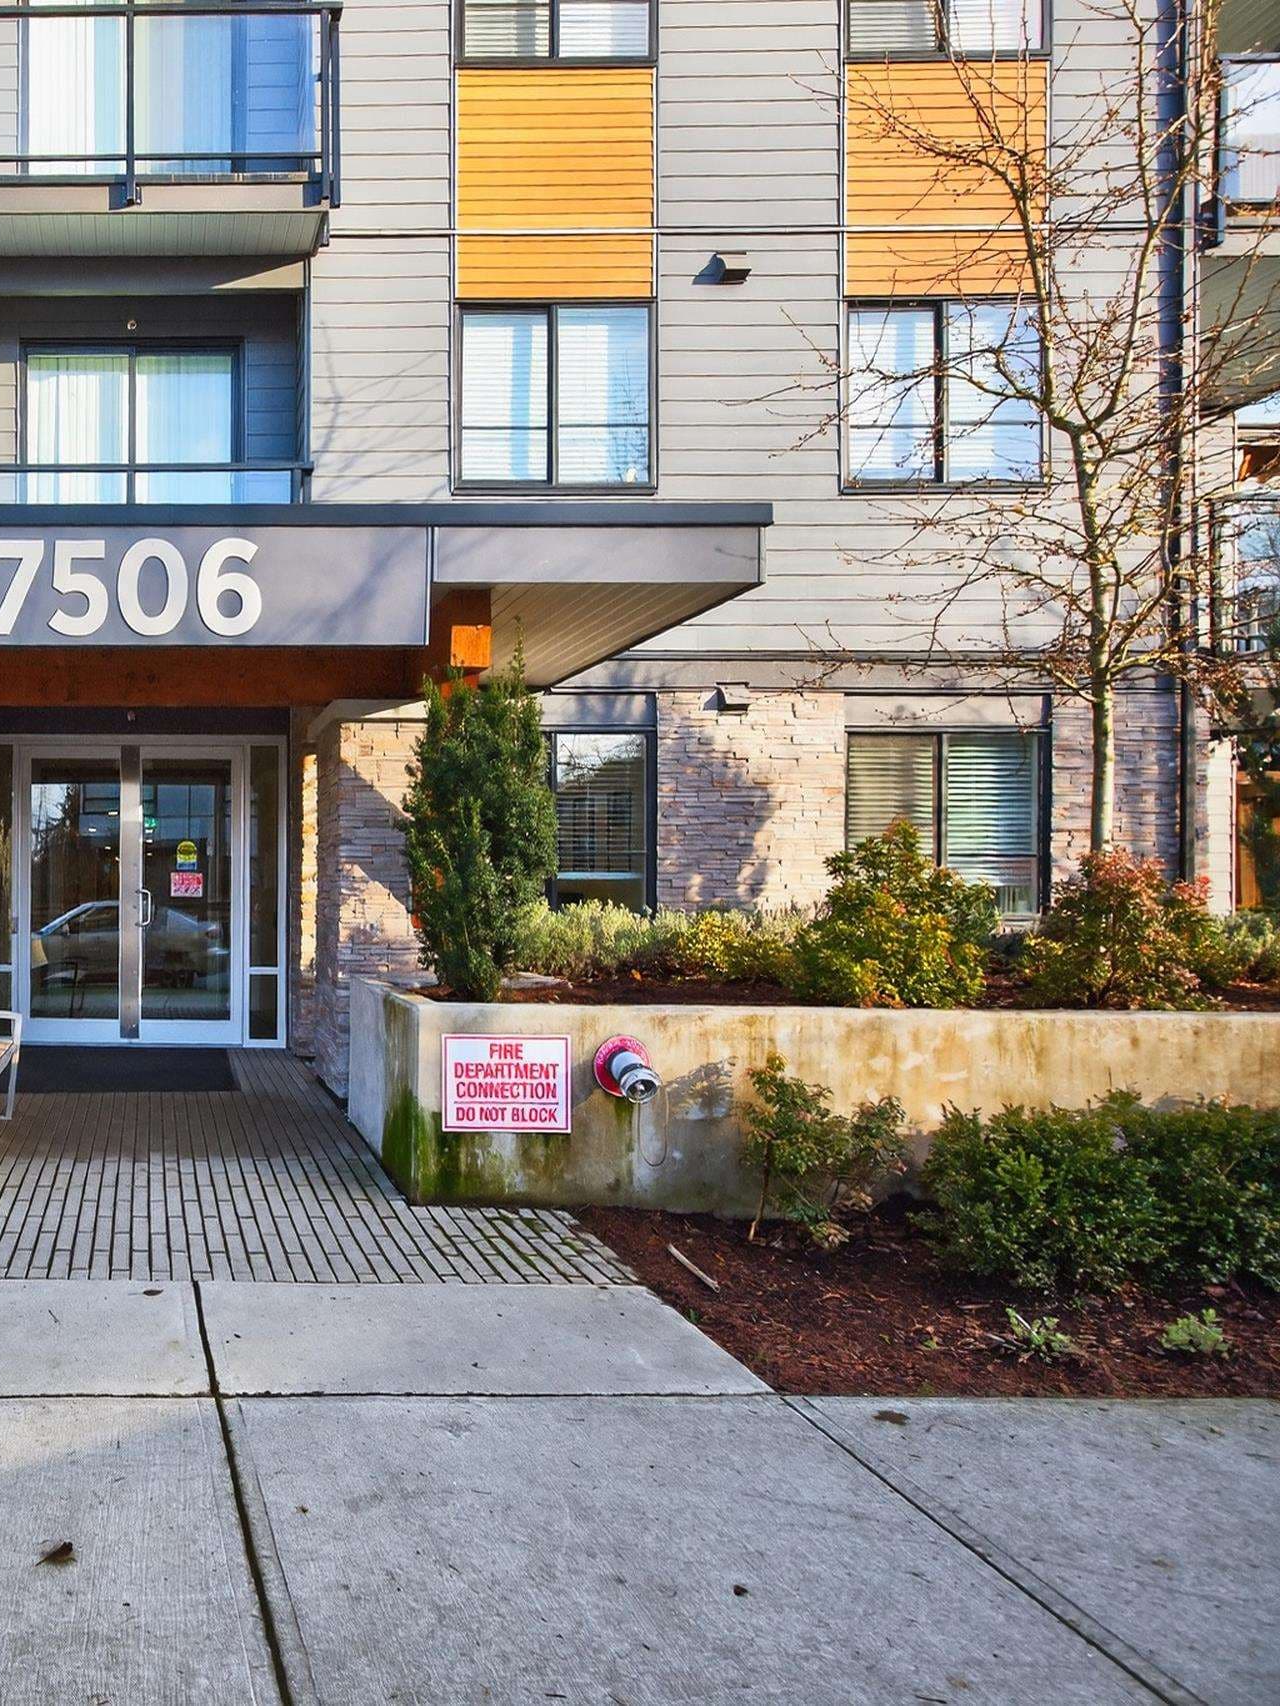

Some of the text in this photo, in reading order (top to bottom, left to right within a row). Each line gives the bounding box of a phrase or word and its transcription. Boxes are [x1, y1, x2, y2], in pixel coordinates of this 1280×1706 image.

[489, 1043, 523, 1060] FIRE
[454, 1062, 560, 1080] DEPARTMENT
[456, 1082, 557, 1100] CONNECTION
[455, 1107, 558, 1123] DO NOT BLOCK
